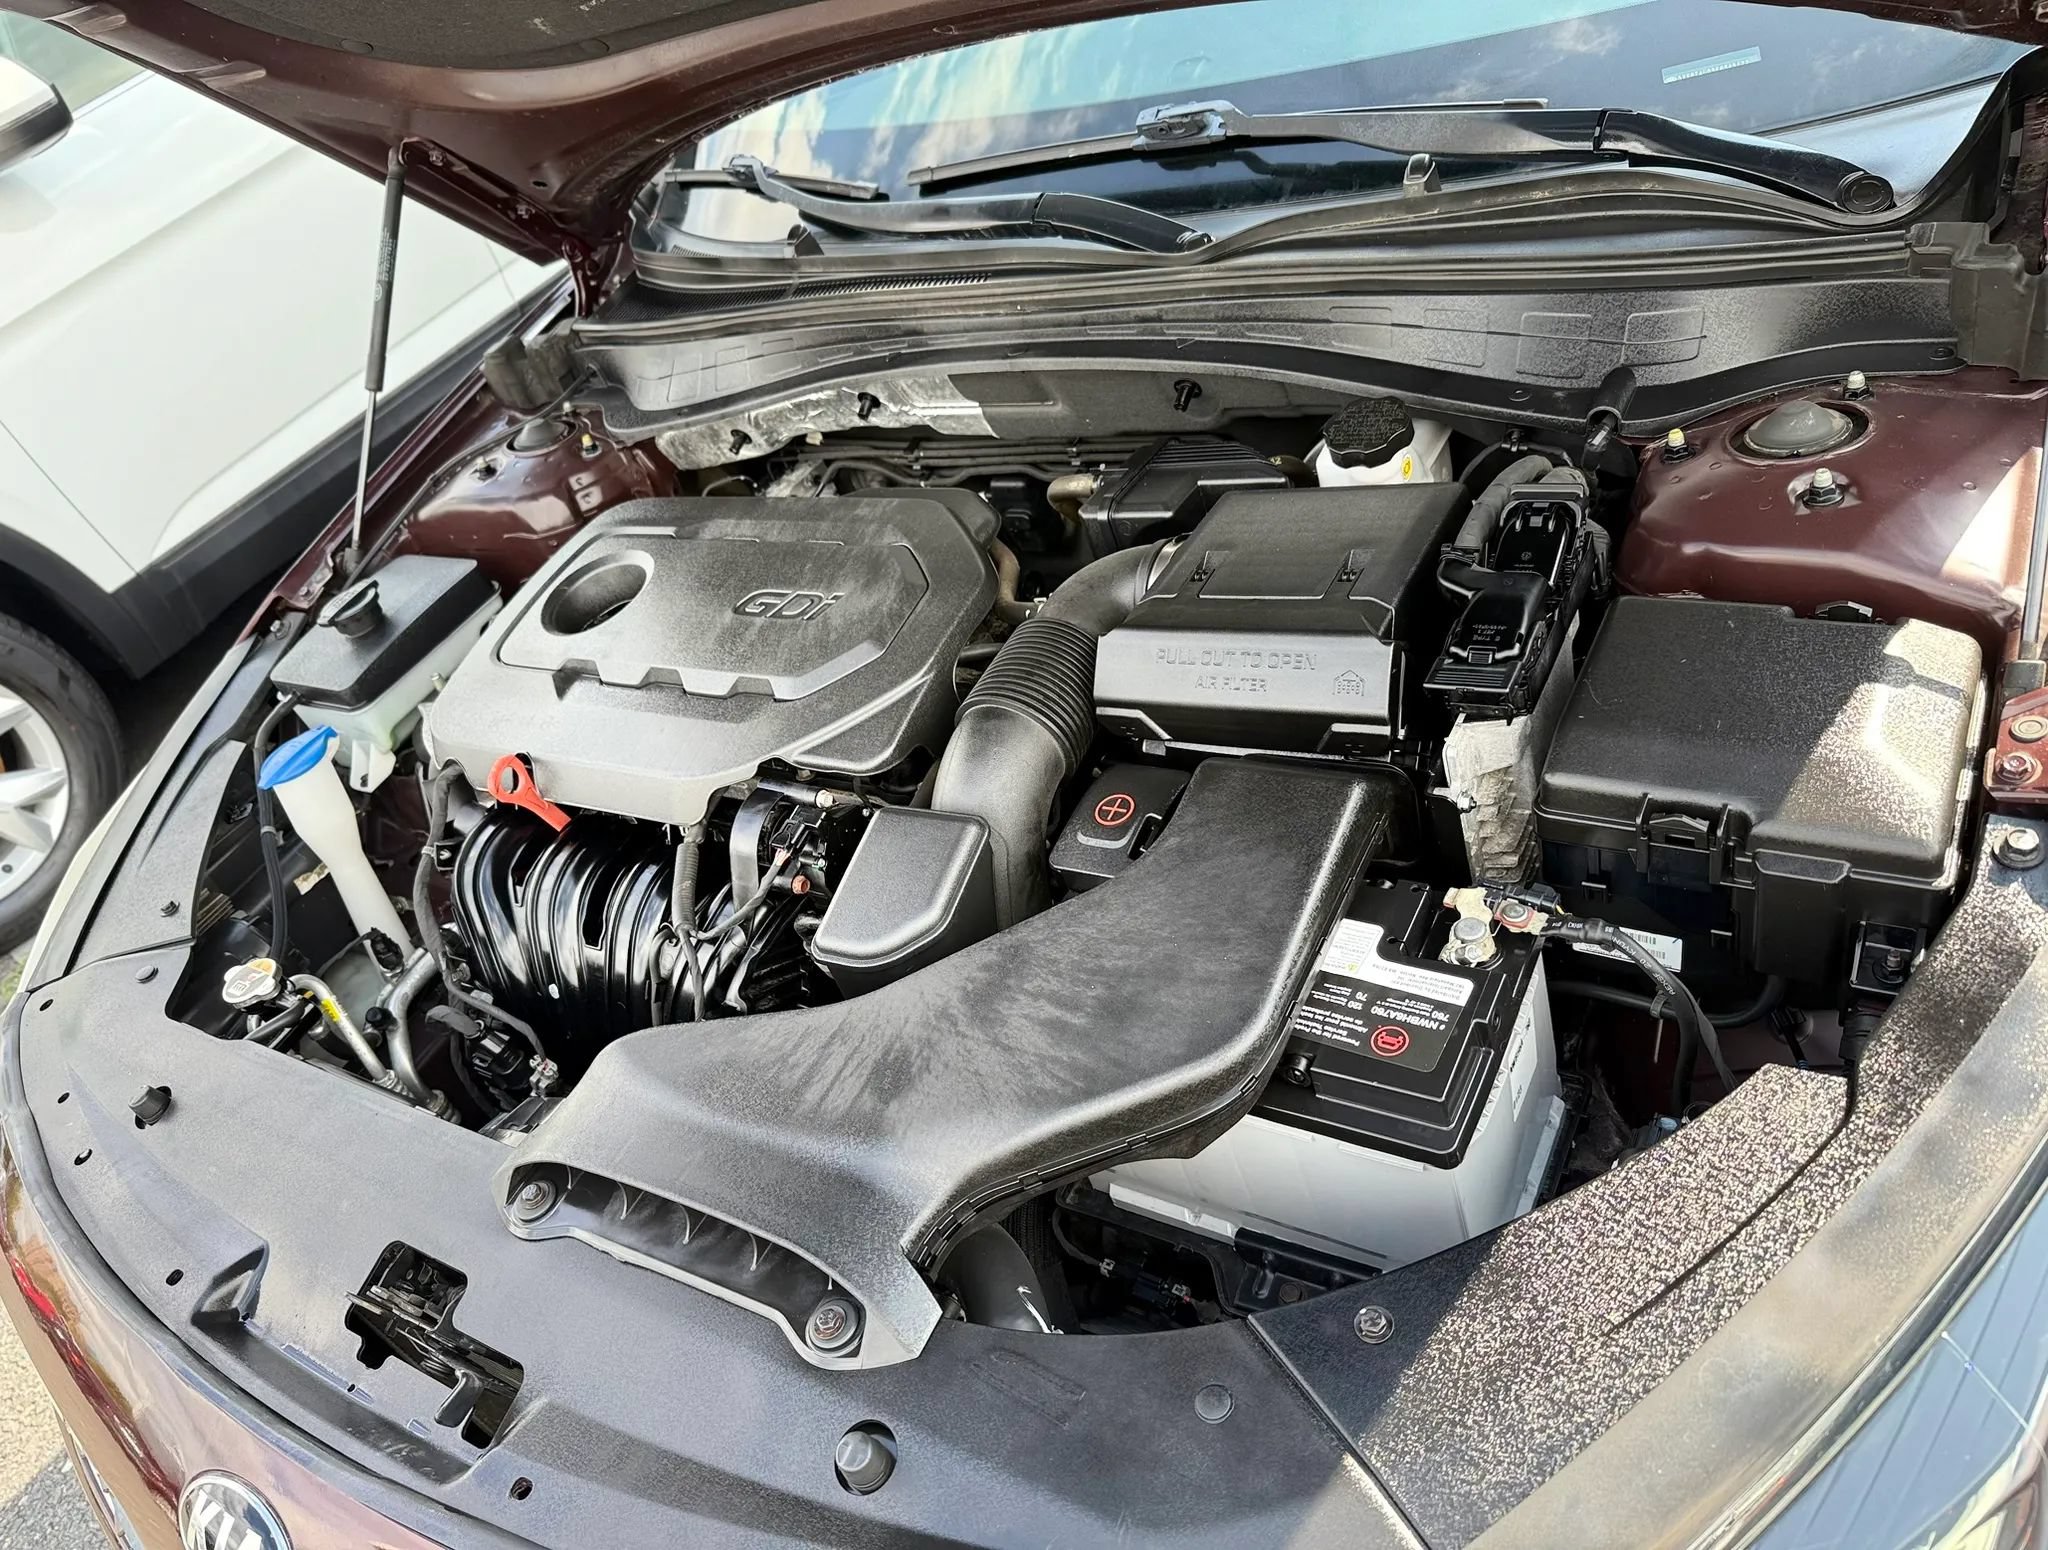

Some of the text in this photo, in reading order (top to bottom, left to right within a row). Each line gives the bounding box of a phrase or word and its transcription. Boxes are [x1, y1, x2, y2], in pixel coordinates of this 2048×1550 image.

[1156, 648, 1317, 670] PULL OUT TO OPEN
[1195, 675, 1267, 692] AIR FILTER
[1355, 991, 1367, 1001] 70
[1347, 1000, 1363, 1010] 120
[1370, 1005, 1439, 1029] NWBH6A760
[1431, 1010, 1449, 1022] 760
